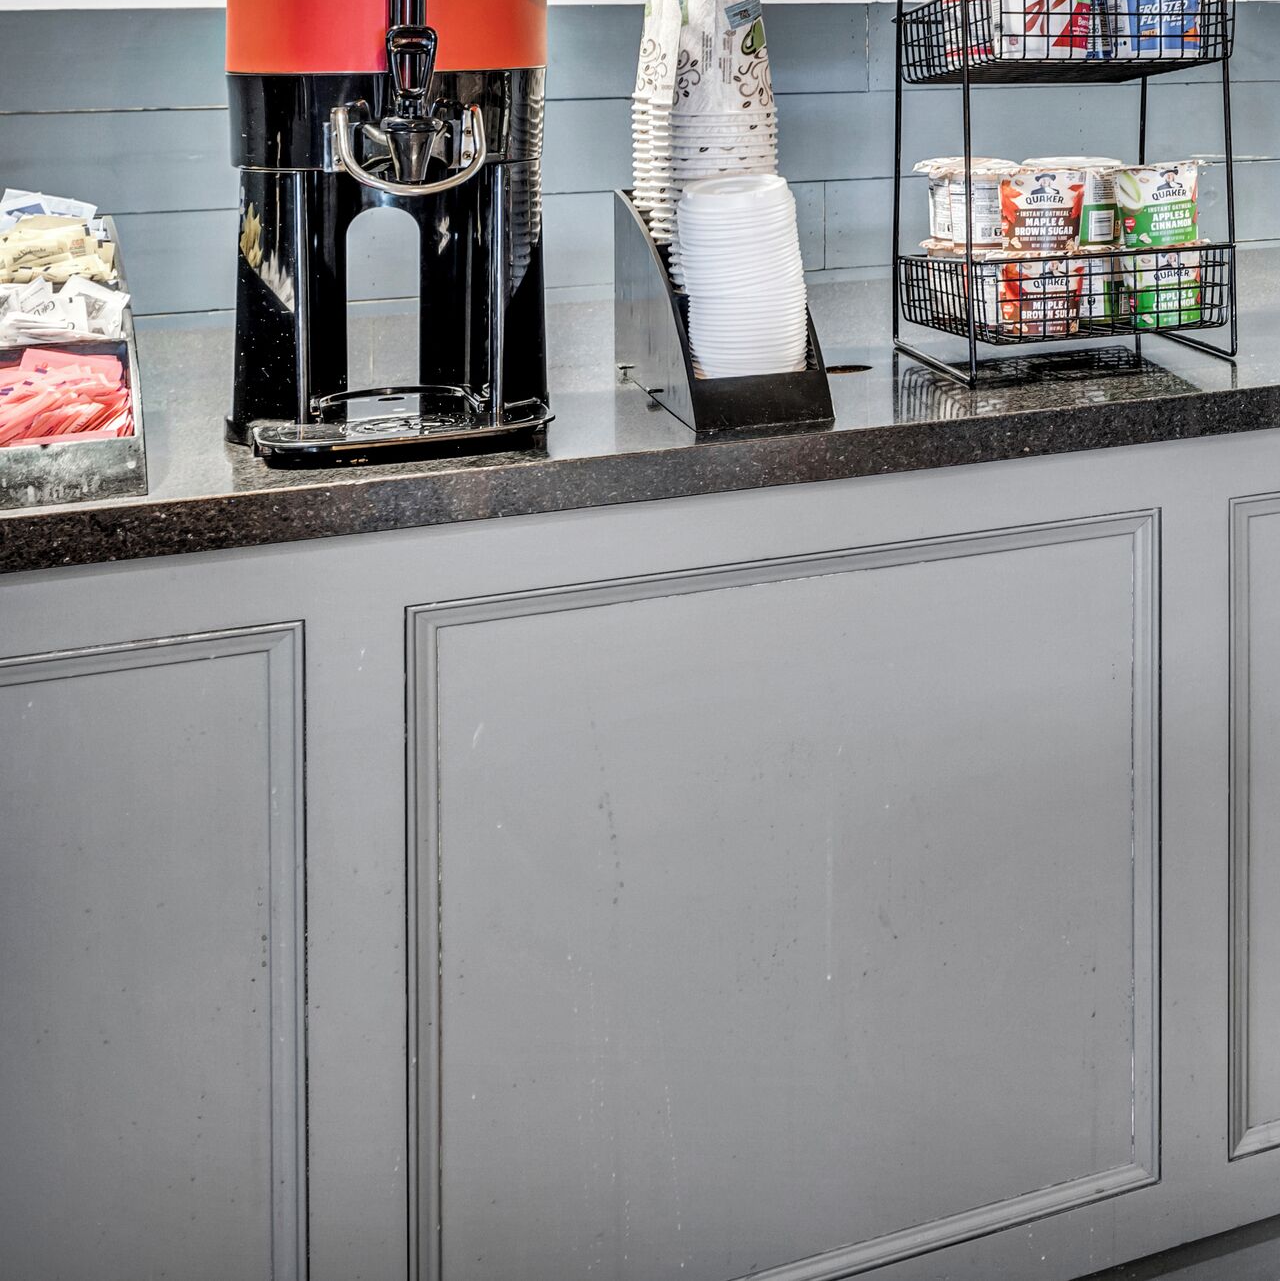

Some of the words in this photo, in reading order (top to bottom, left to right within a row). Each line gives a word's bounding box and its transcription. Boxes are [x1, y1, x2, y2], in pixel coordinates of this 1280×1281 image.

[1025, 194, 1065, 205] QUAKER
[1151, 188, 1187, 201] QUAKER
[1152, 211, 1184, 222] APPLES
[1025, 218, 1057, 227] MAPLE
[1150, 218, 1192, 231] CINNAMON
[1014, 226, 1046, 236] BROWN
[1047, 226, 1074, 235] SUGAR
